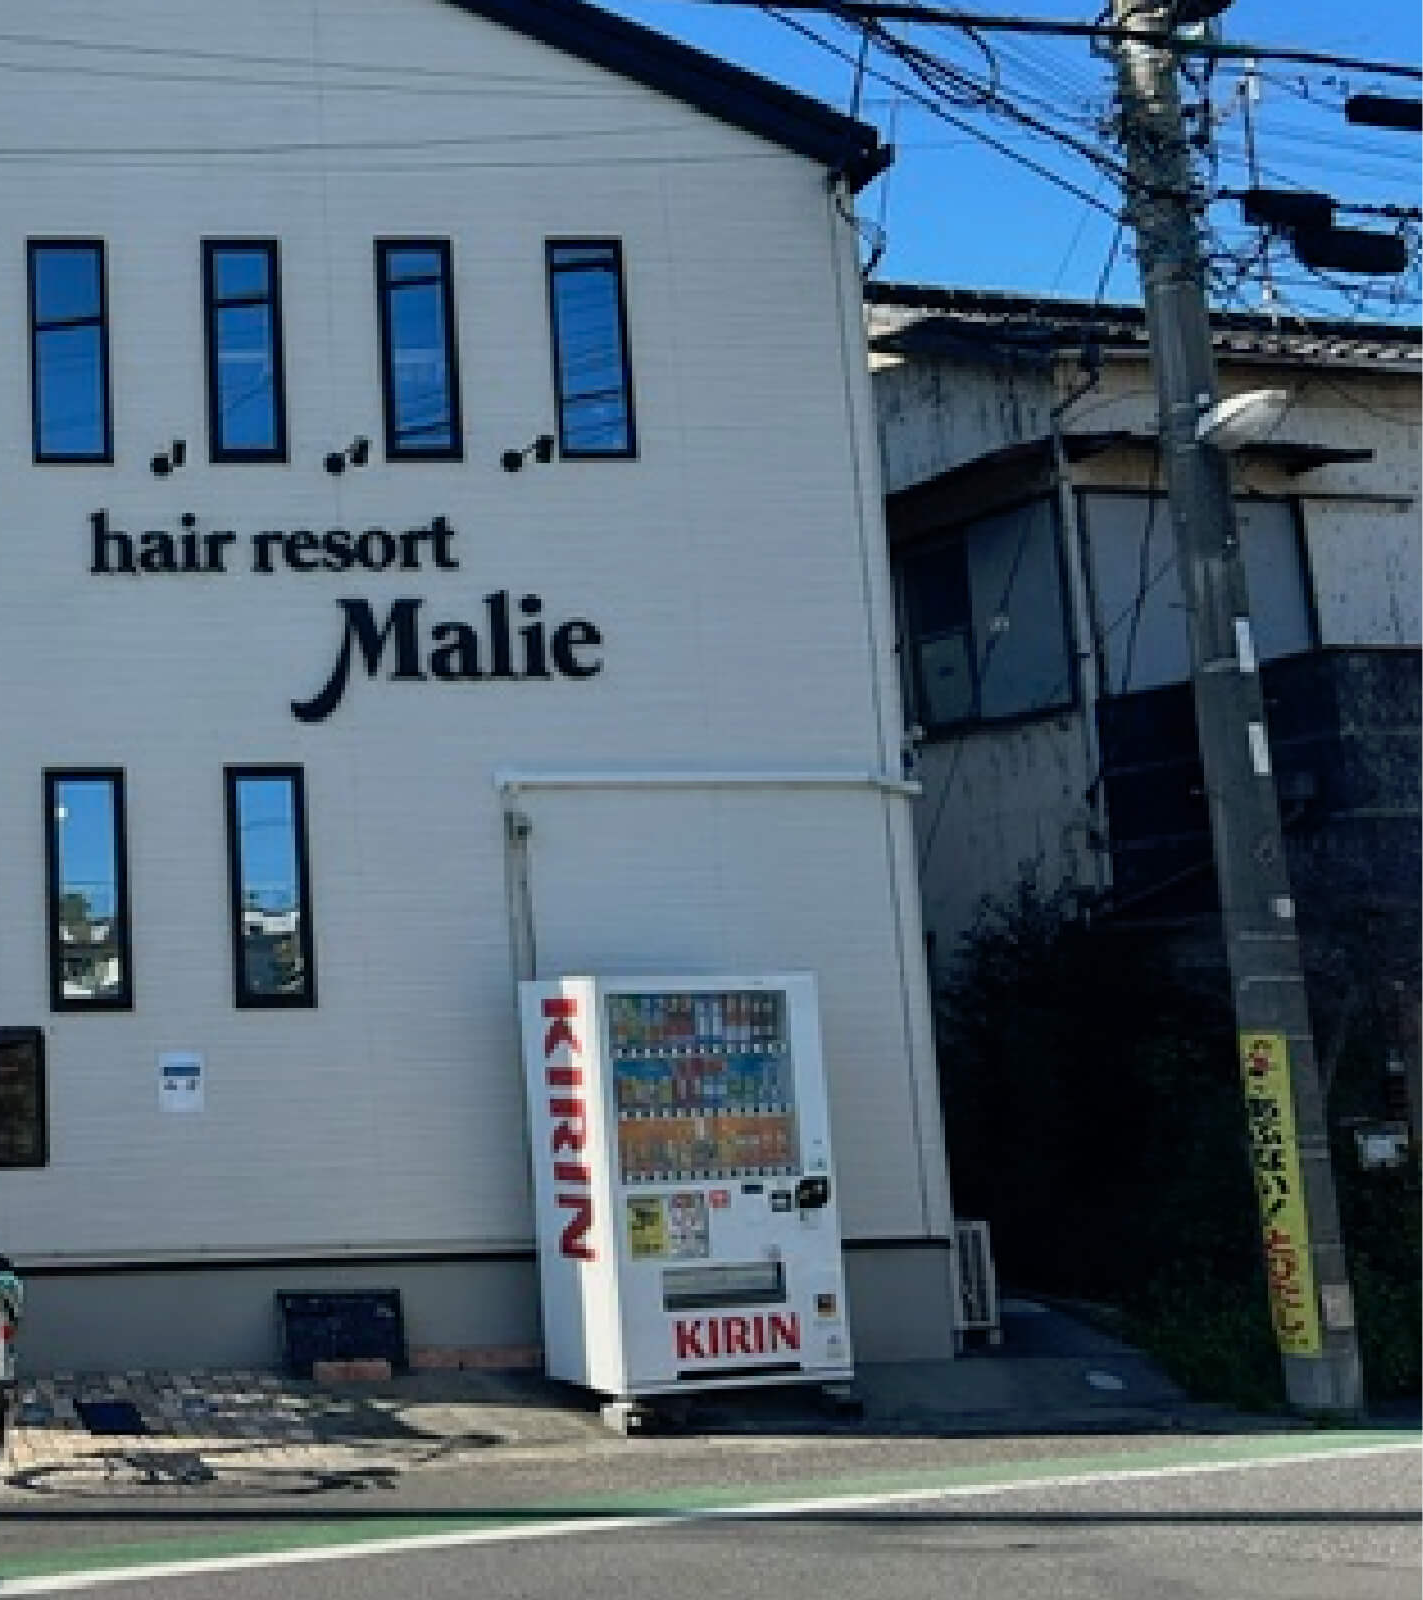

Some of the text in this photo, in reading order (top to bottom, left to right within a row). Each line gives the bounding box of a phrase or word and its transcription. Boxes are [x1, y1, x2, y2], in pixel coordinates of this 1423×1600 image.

[88, 509, 460, 575] hair resort
[290, 590, 603, 722] Malie
[541, 995, 599, 1262] KIRIN
[673, 1312, 801, 1359] KIRIN
